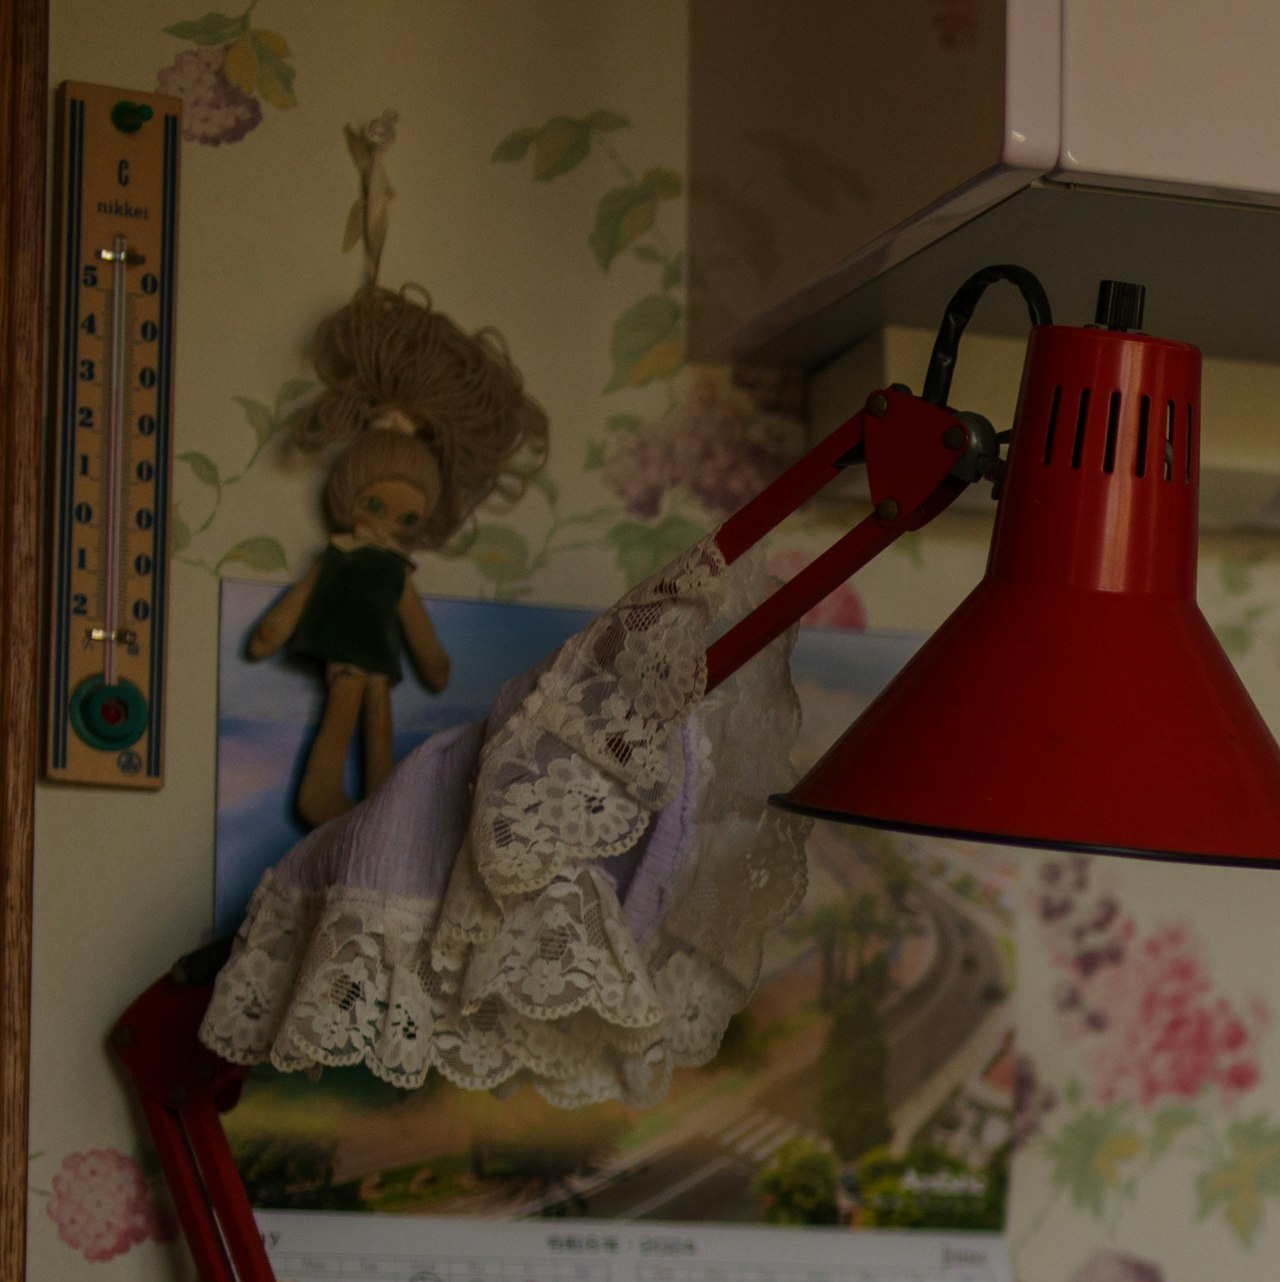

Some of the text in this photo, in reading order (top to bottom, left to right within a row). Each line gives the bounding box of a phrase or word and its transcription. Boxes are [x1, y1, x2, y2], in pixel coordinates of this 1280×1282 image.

[96, 199, 150, 222] nikkei
[82, 265, 158, 295] 5 0
[79, 314, 157, 343] 4 0
[78, 360, 156, 388] 3 0
[77, 407, 155, 437] 2 0
[78, 454, 154, 483] 1 0
[75, 503, 153, 531] 0 0
[75, 549, 152, 575] 1 0
[72, 594, 150, 622] 2 0
